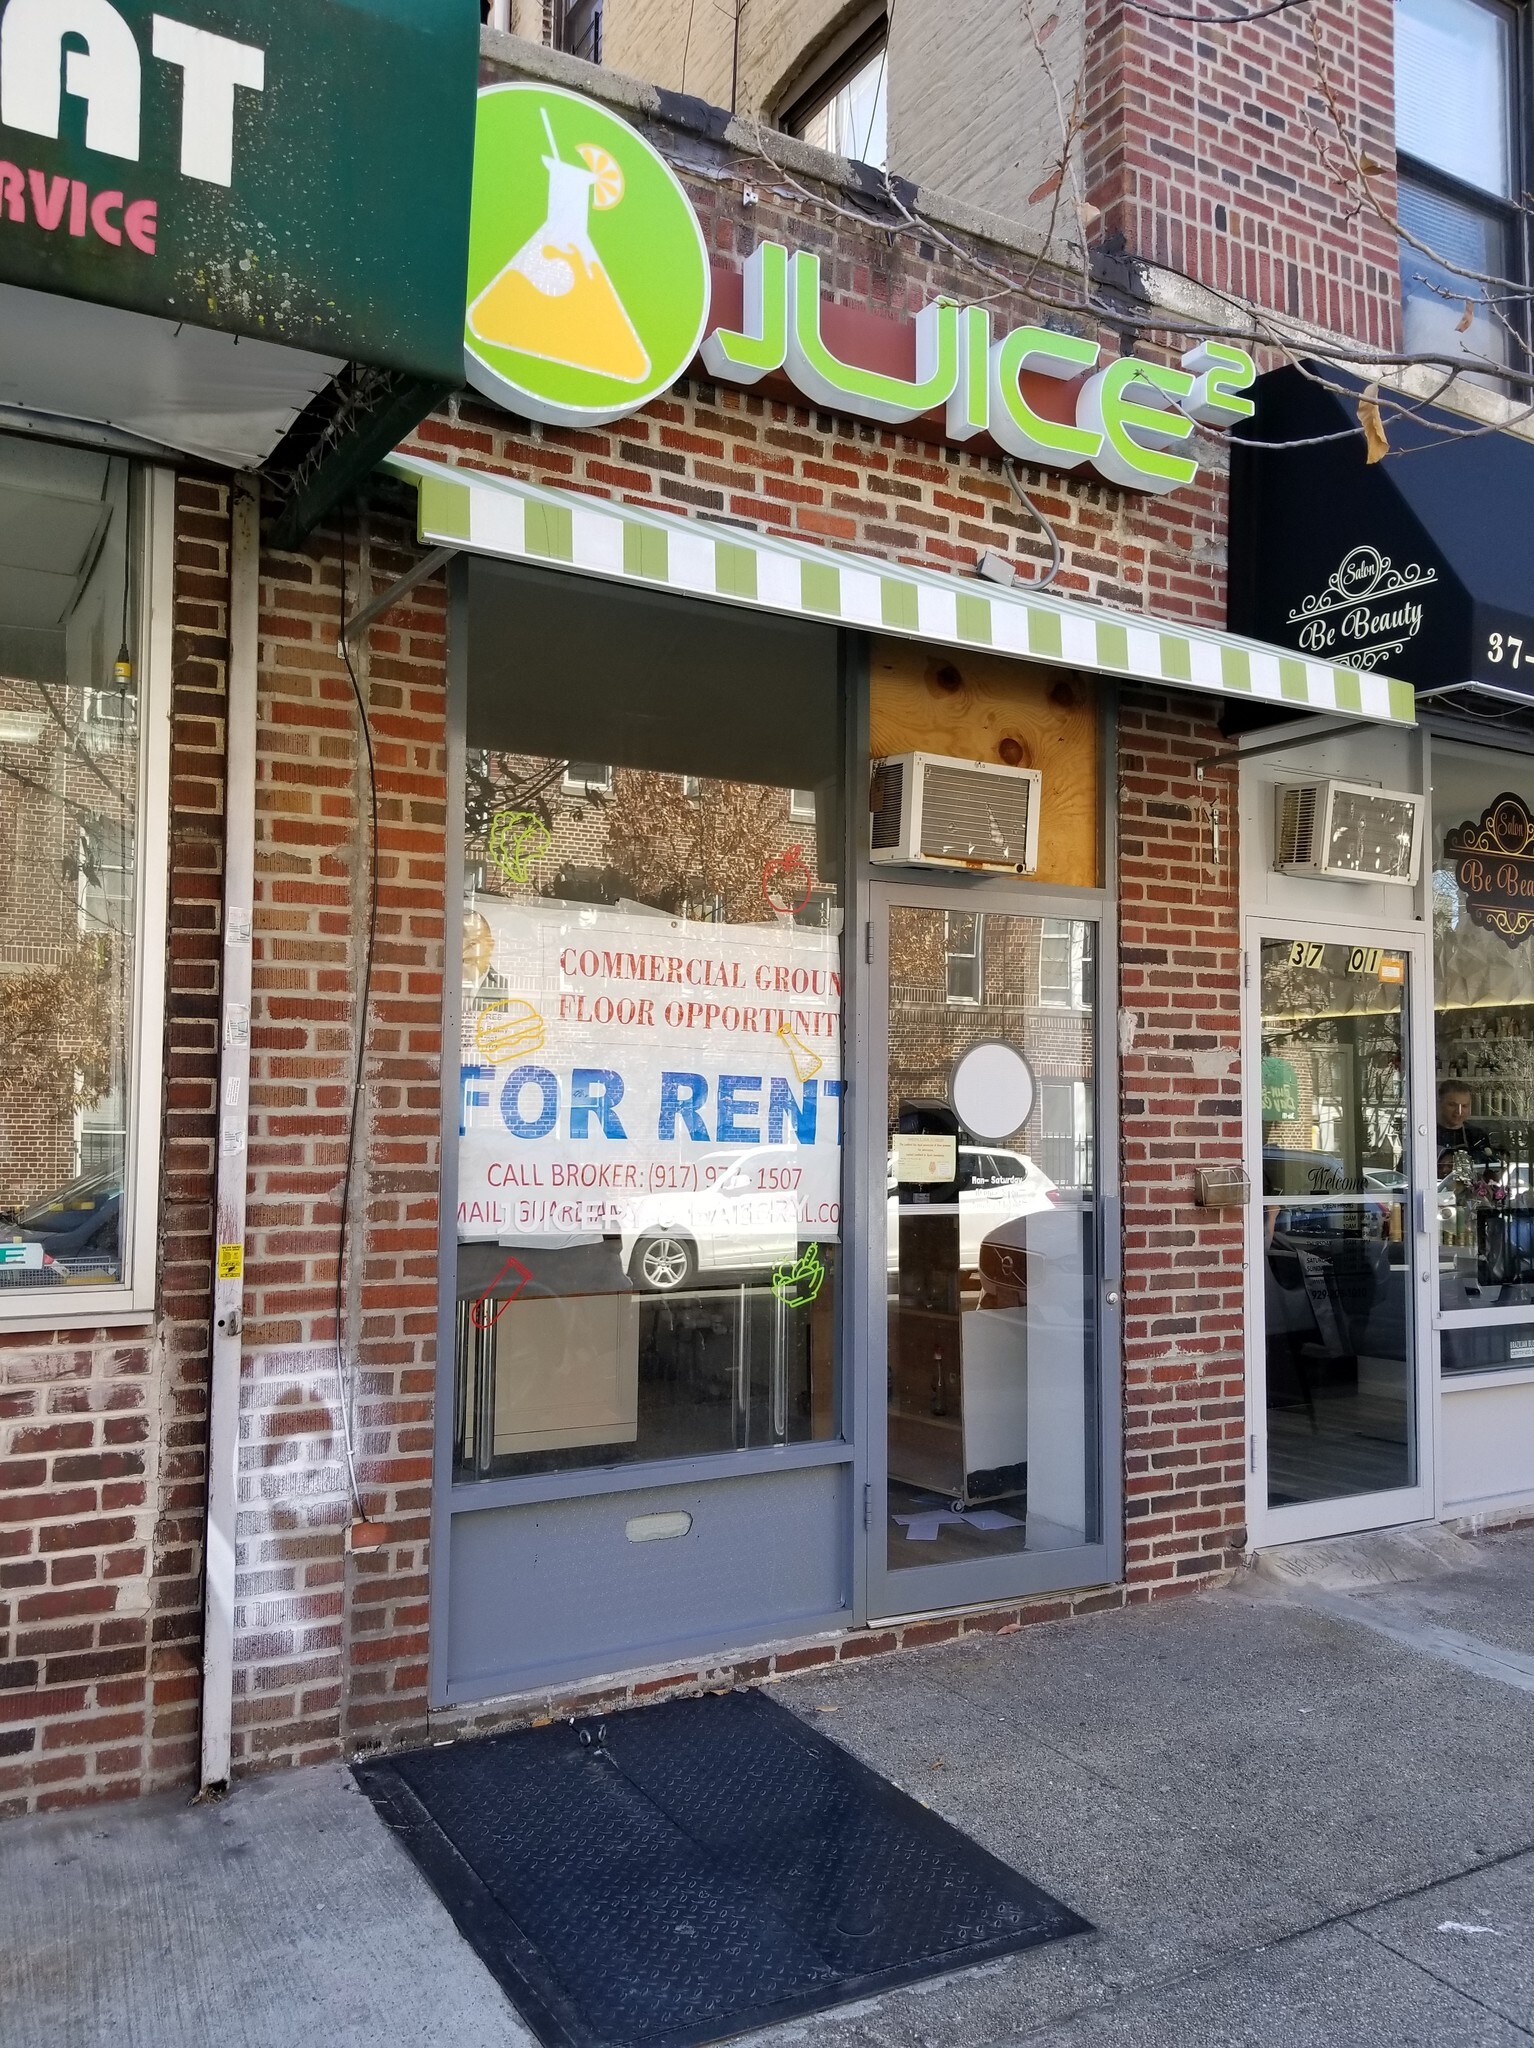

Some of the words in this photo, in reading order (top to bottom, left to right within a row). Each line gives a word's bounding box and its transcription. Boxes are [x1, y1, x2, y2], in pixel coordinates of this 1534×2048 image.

[1343, 560, 1376, 586] Salon
[1298, 619, 1336, 651] Be
[1341, 601, 1424, 640] Beauty
[1498, 812, 1524, 837] Salon
[1461, 858, 1493, 892] Be
[560, 948, 747, 989] COMMERCIAL
[1292, 942, 1324, 967] 37
[1351, 949, 1378, 972] 01
[558, 993, 655, 1027] FLOOR
[487, 1162, 544, 1187] CALL
[552, 1163, 644, 1188] BROKER:
[649, 1163, 698, 1193] (917)
[757, 1167, 803, 1191] 1507
[1307, 1166, 1369, 1191] Welcome
